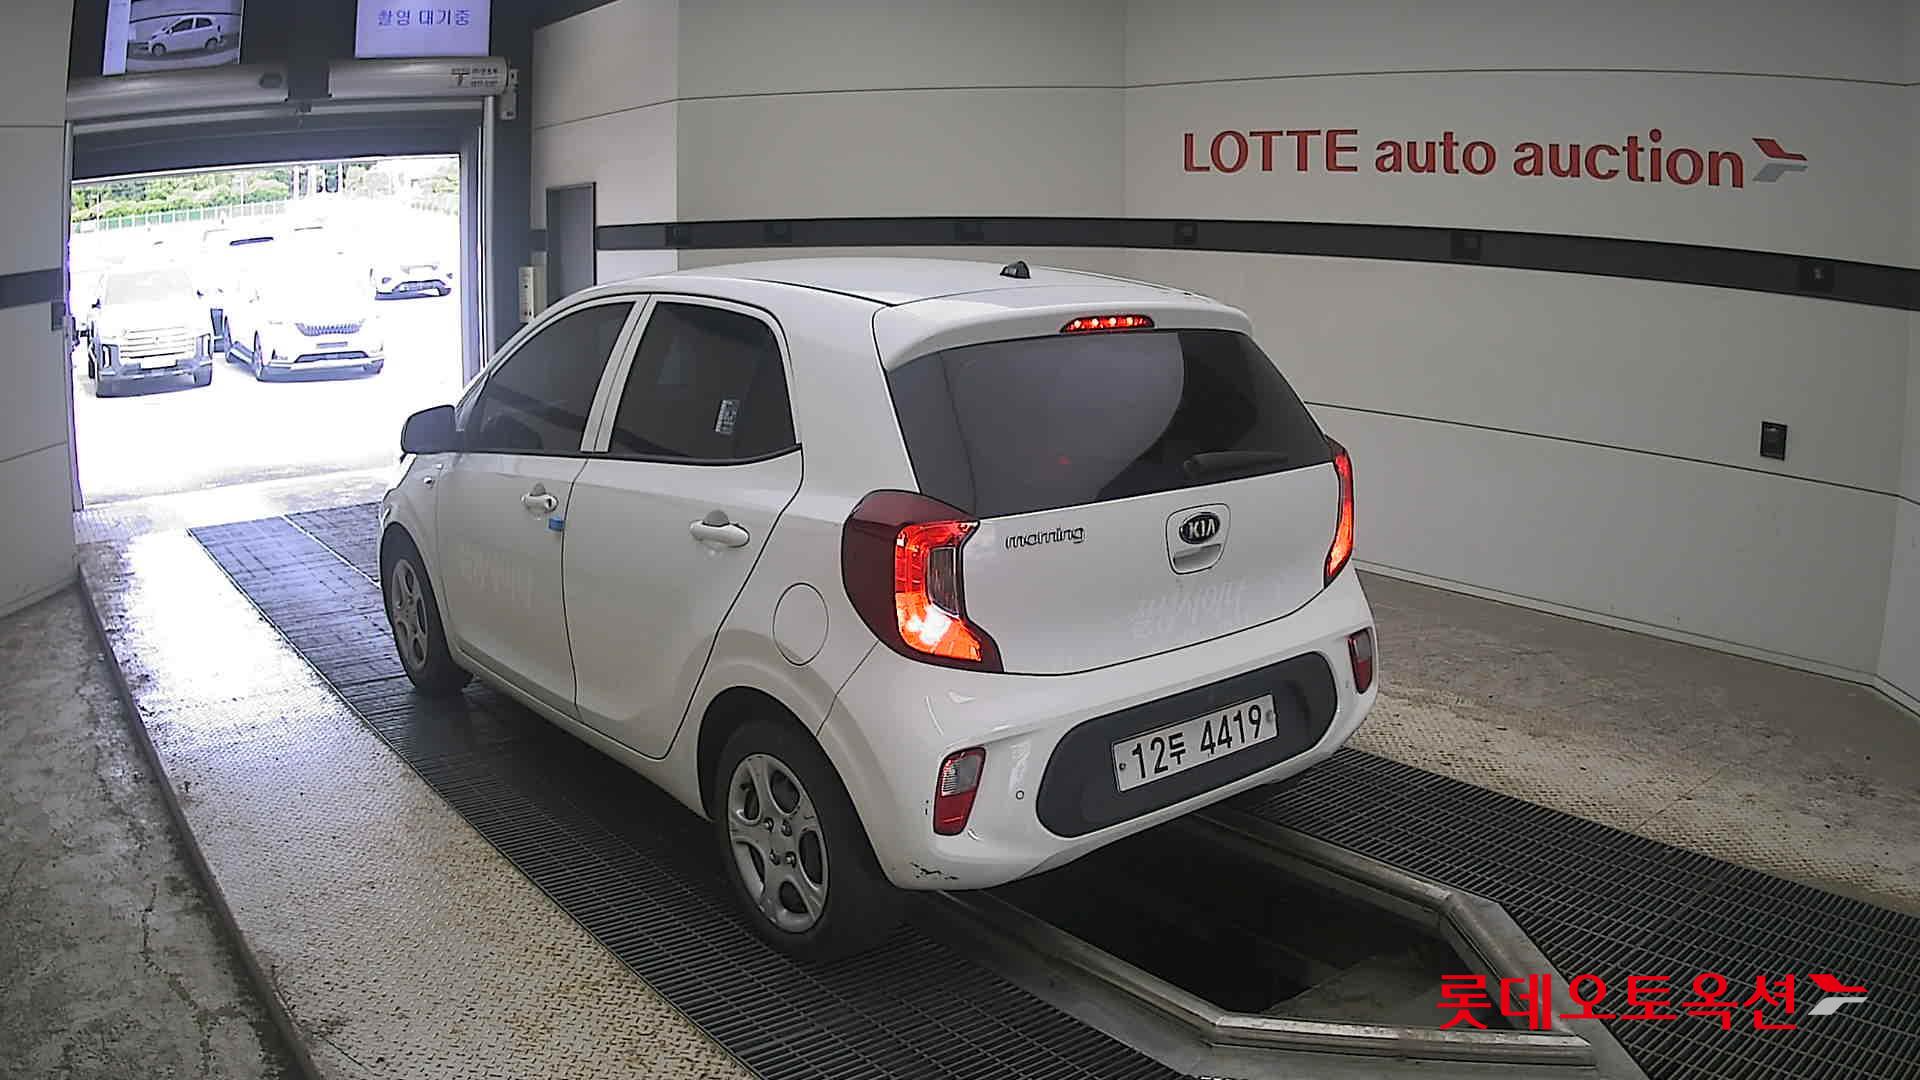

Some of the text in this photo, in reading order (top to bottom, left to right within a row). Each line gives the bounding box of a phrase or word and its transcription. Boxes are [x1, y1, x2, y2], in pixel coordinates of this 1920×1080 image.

[419, 8, 470, 26] 대기중
[1183, 128, 1744, 189] LOTTE auto auction
[1004, 526, 1084, 550] morning
[1187, 518, 1216, 538] KIA
[1131, 703, 1263, 780] 12두 4419
